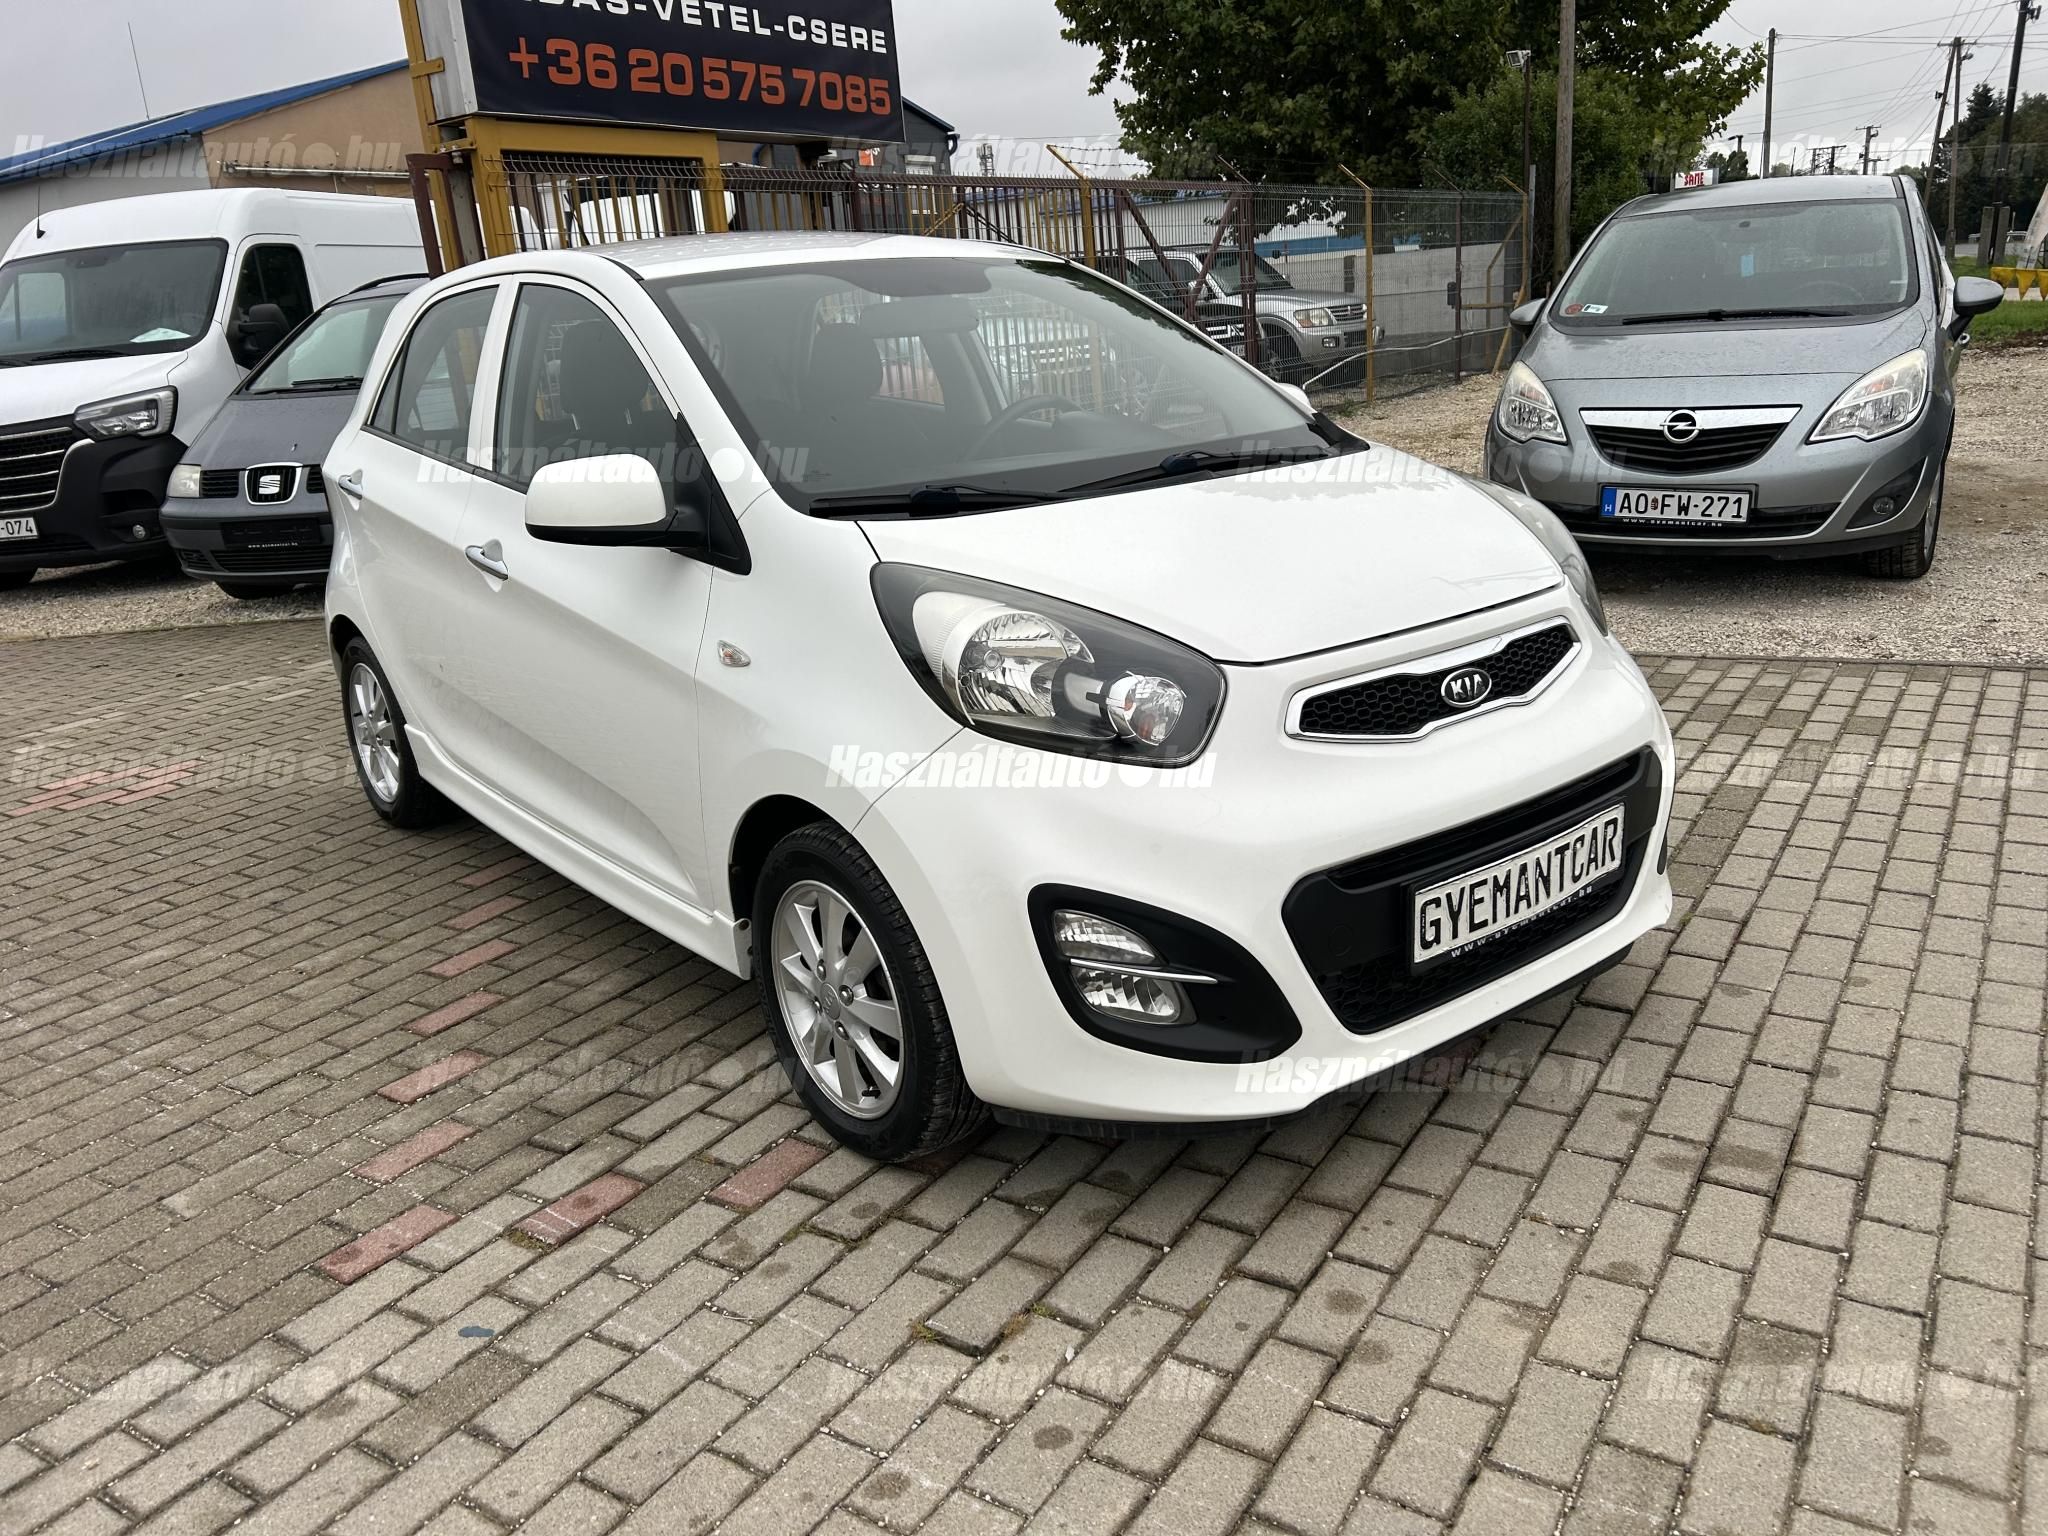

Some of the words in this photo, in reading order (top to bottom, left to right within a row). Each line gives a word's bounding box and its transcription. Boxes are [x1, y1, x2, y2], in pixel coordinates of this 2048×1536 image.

[509, 37, 617, 89] +36
[628, 48, 693, 96] 20
[702, 57, 785, 104] 575
[791, 68, 891, 115] 7085
[1450, 673, 1486, 699] KIA
[1419, 816, 1619, 950] GYEMANTCAR
